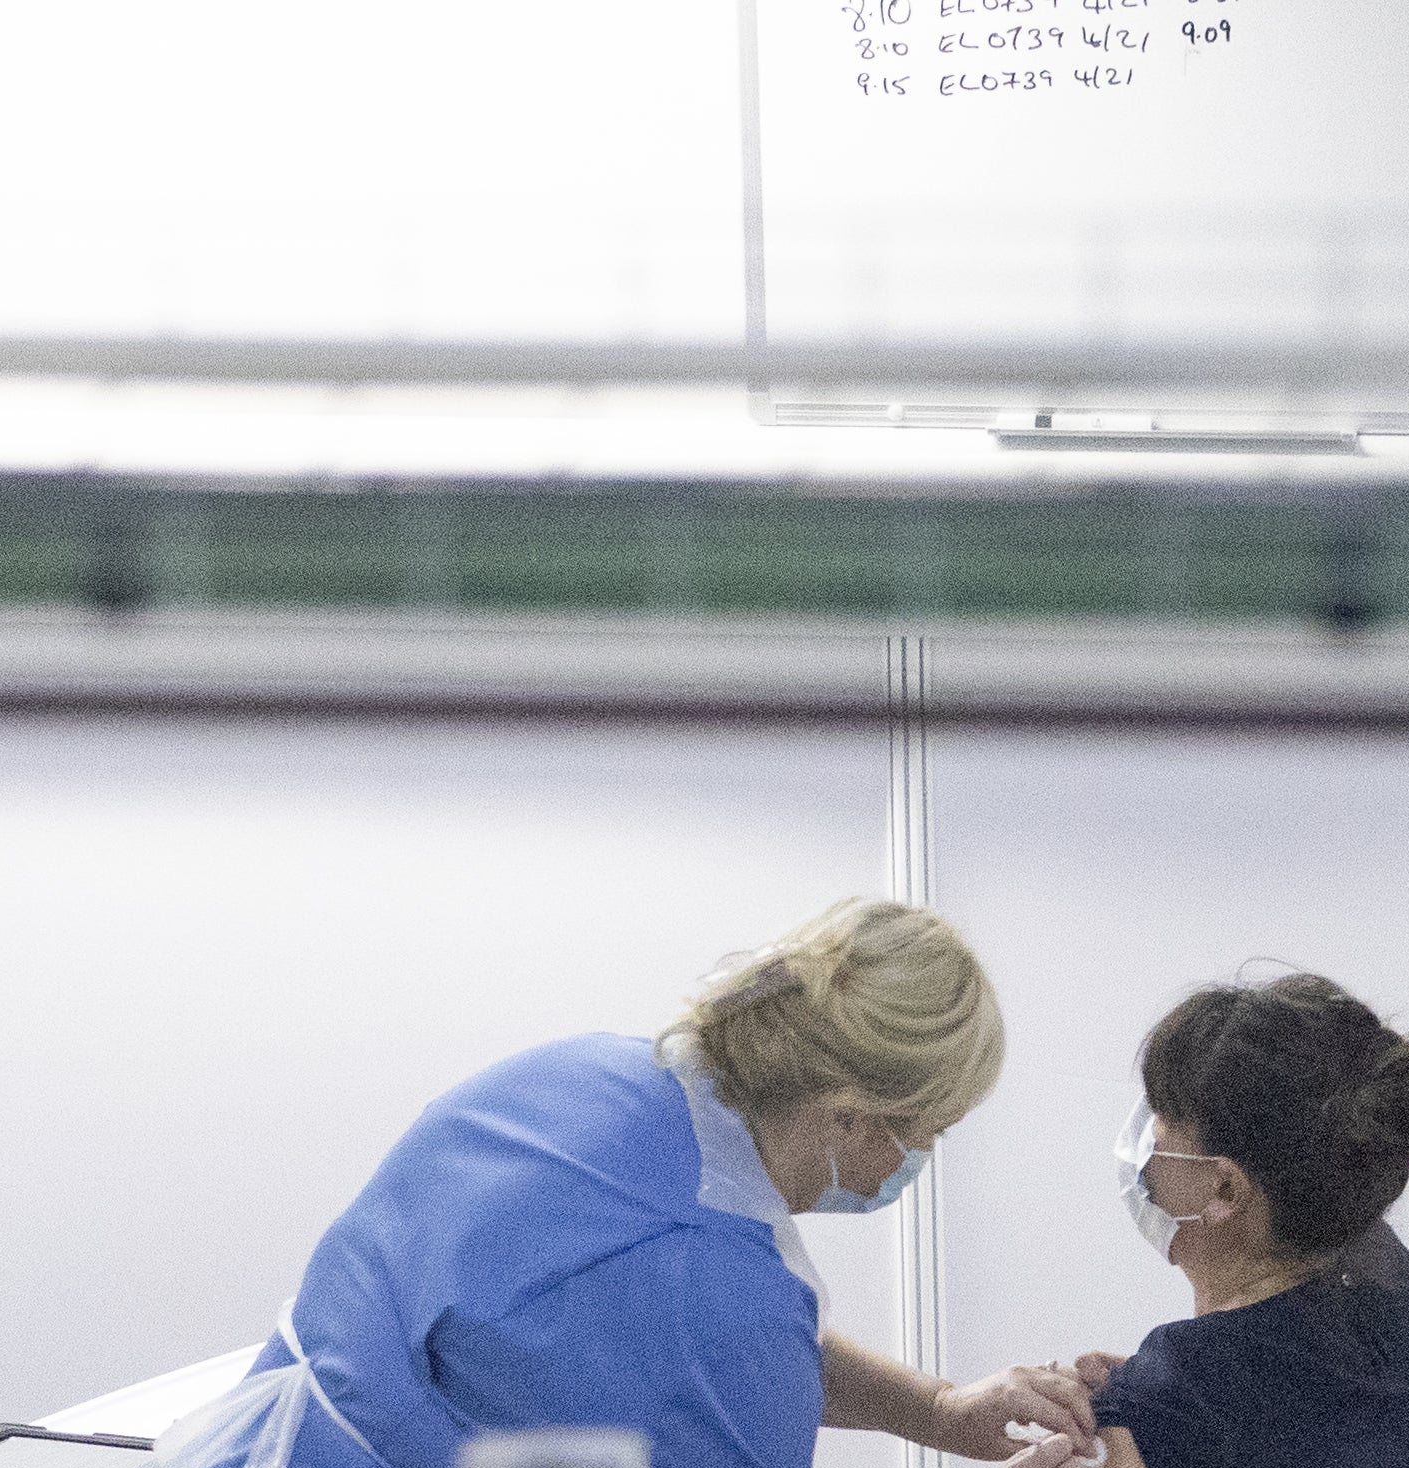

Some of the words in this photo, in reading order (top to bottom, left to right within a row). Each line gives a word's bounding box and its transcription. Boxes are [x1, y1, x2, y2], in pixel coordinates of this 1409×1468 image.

[855, 38, 909, 60] 8.10
[938, 26, 1065, 52] EL0739
[1181, 19, 1232, 45] 9.09
[857, 72, 911, 96] 9.15
[939, 69, 1053, 96] EL0739
[1073, 65, 1133, 89] 4/21
